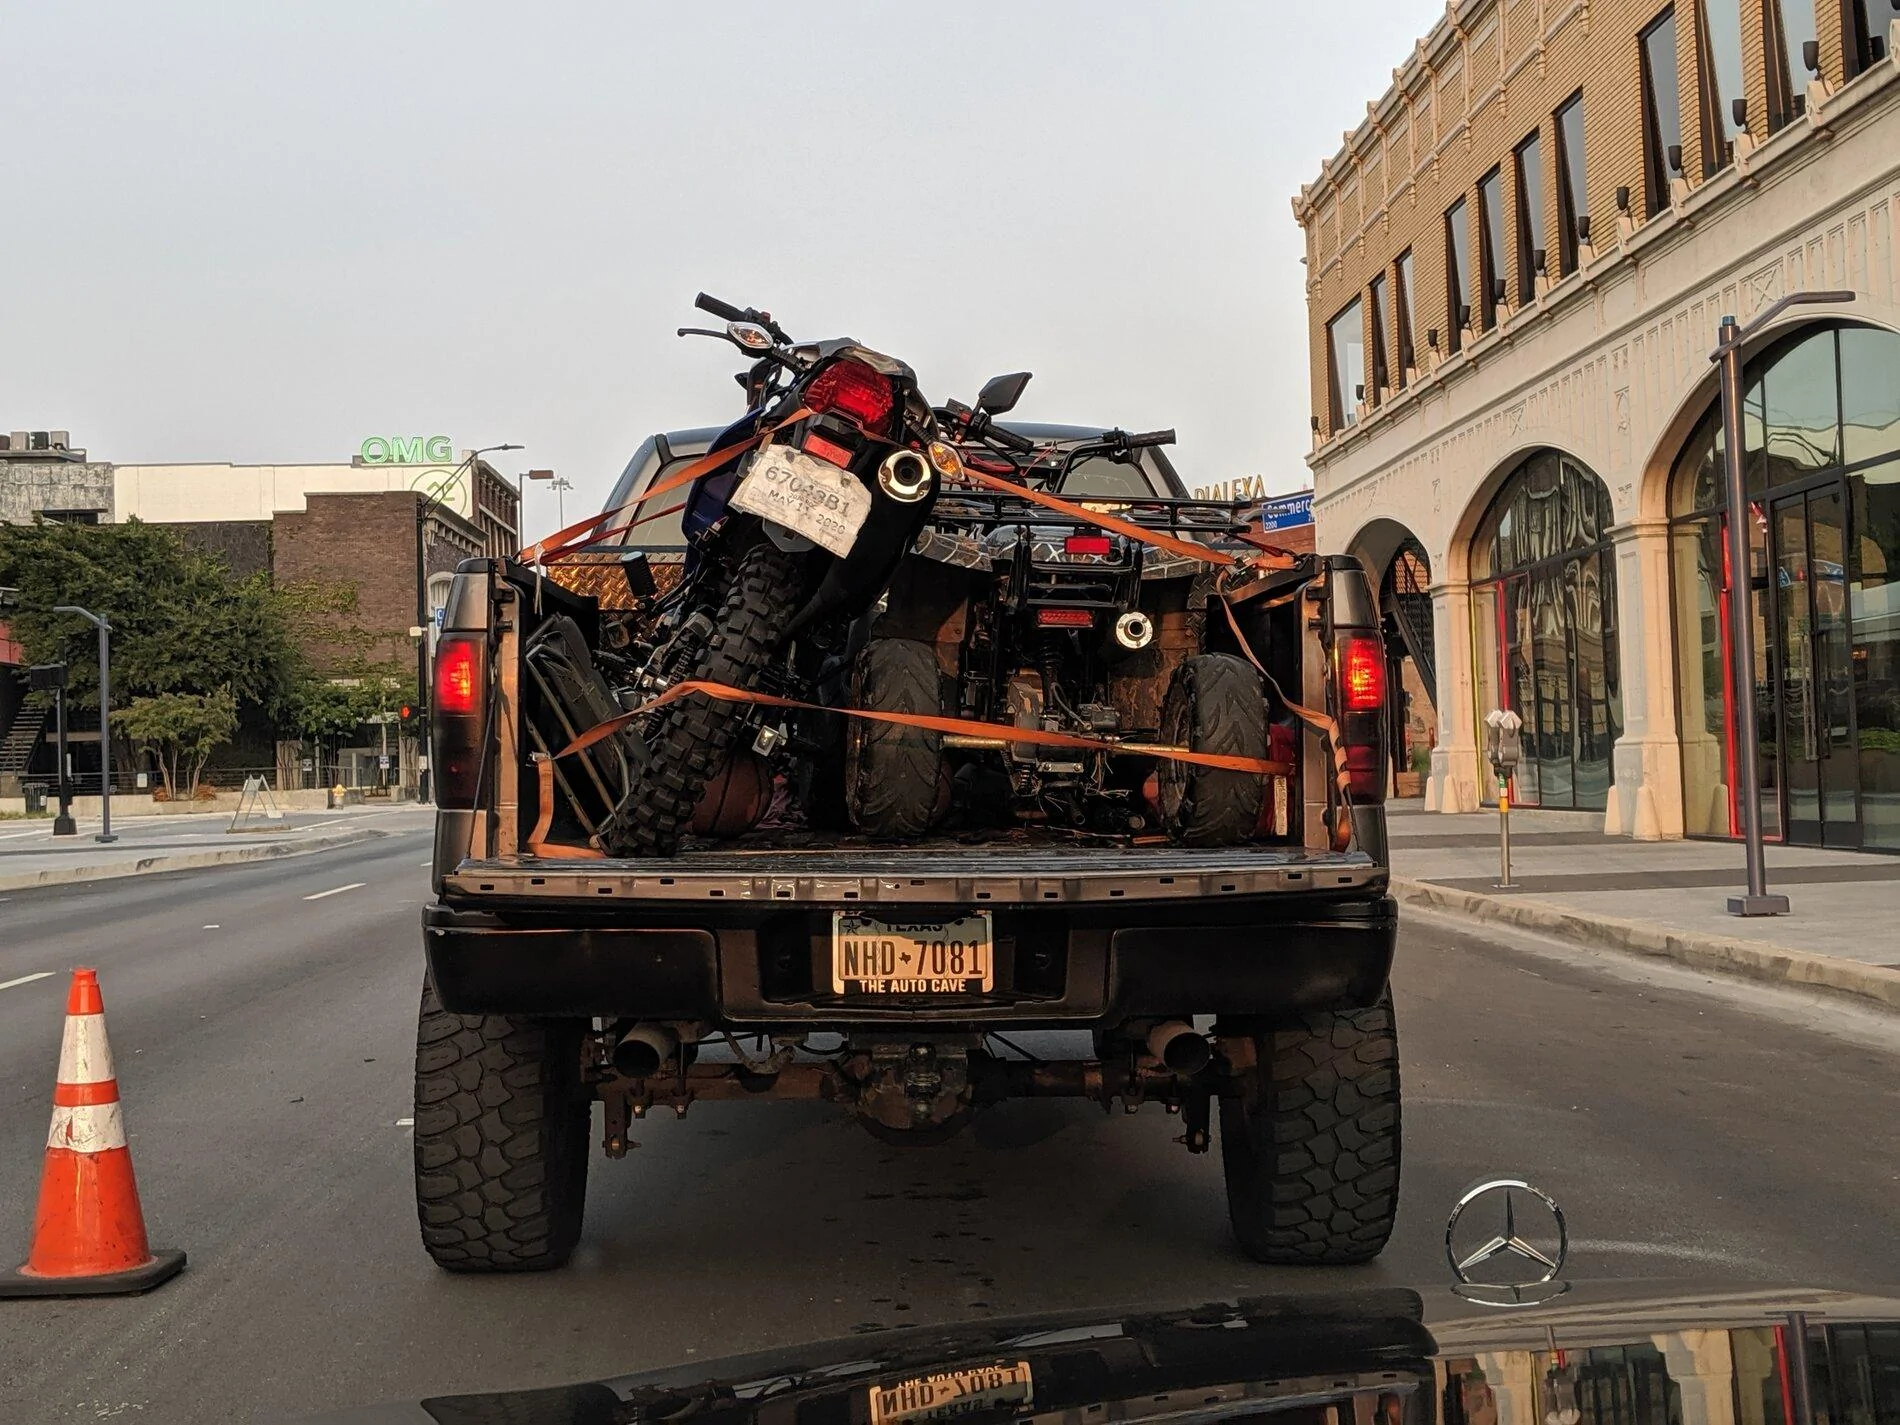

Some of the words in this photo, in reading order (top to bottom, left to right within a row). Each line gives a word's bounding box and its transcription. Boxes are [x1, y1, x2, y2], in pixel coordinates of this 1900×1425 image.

[361, 435, 453, 463] OMG
[768, 489, 795, 506] MAY
[816, 513, 846, 535] 2020
[844, 940, 895, 976] NHD
[913, 940, 983, 976] 7081
[859, 979, 886, 993] THE
[890, 979, 927, 993] AUTO
[931, 978, 967, 993] CAVE
